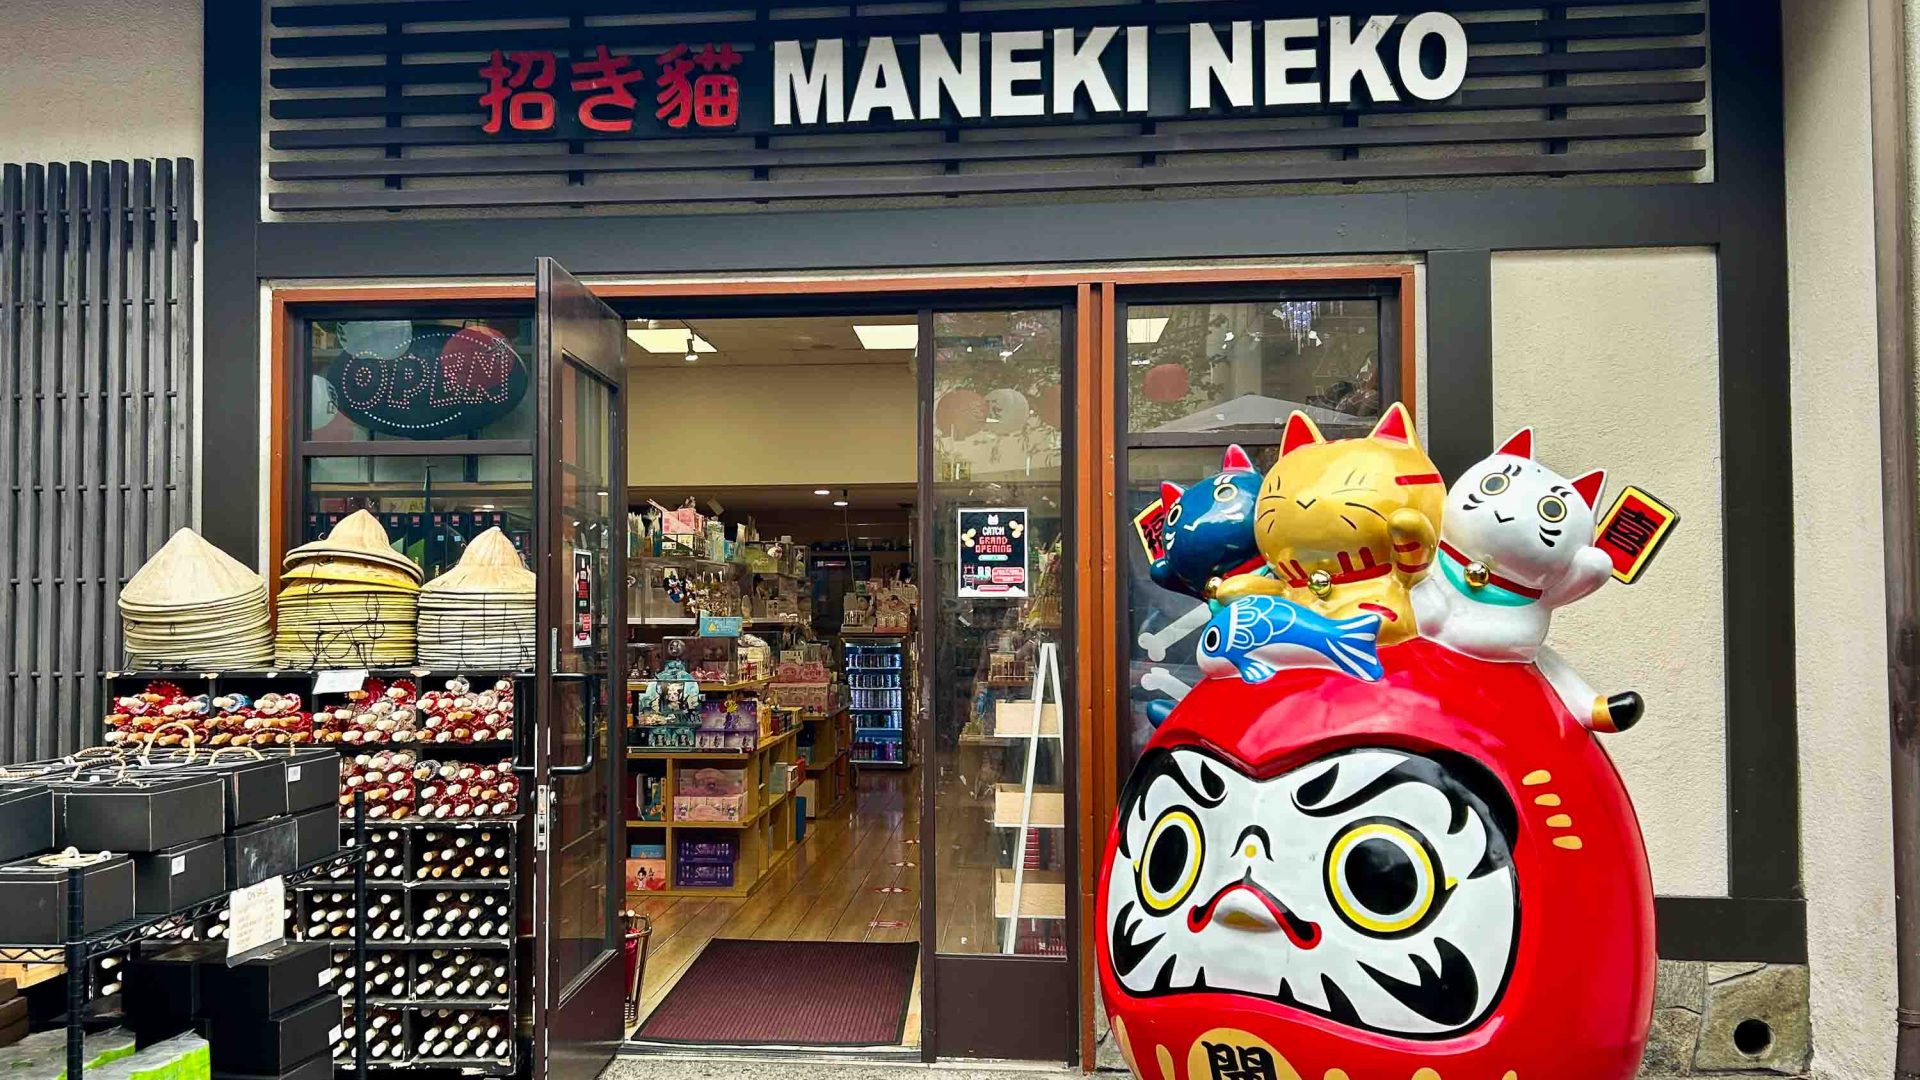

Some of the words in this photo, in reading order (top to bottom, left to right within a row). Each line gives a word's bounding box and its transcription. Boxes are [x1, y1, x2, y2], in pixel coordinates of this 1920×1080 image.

[773, 25, 1149, 126] MANEKI
[1189, 11, 1468, 109] NEKO
[342, 350, 509, 410] OPEN
[975, 544, 1012, 553] OPENING
[979, 536, 1008, 544] GRAND
